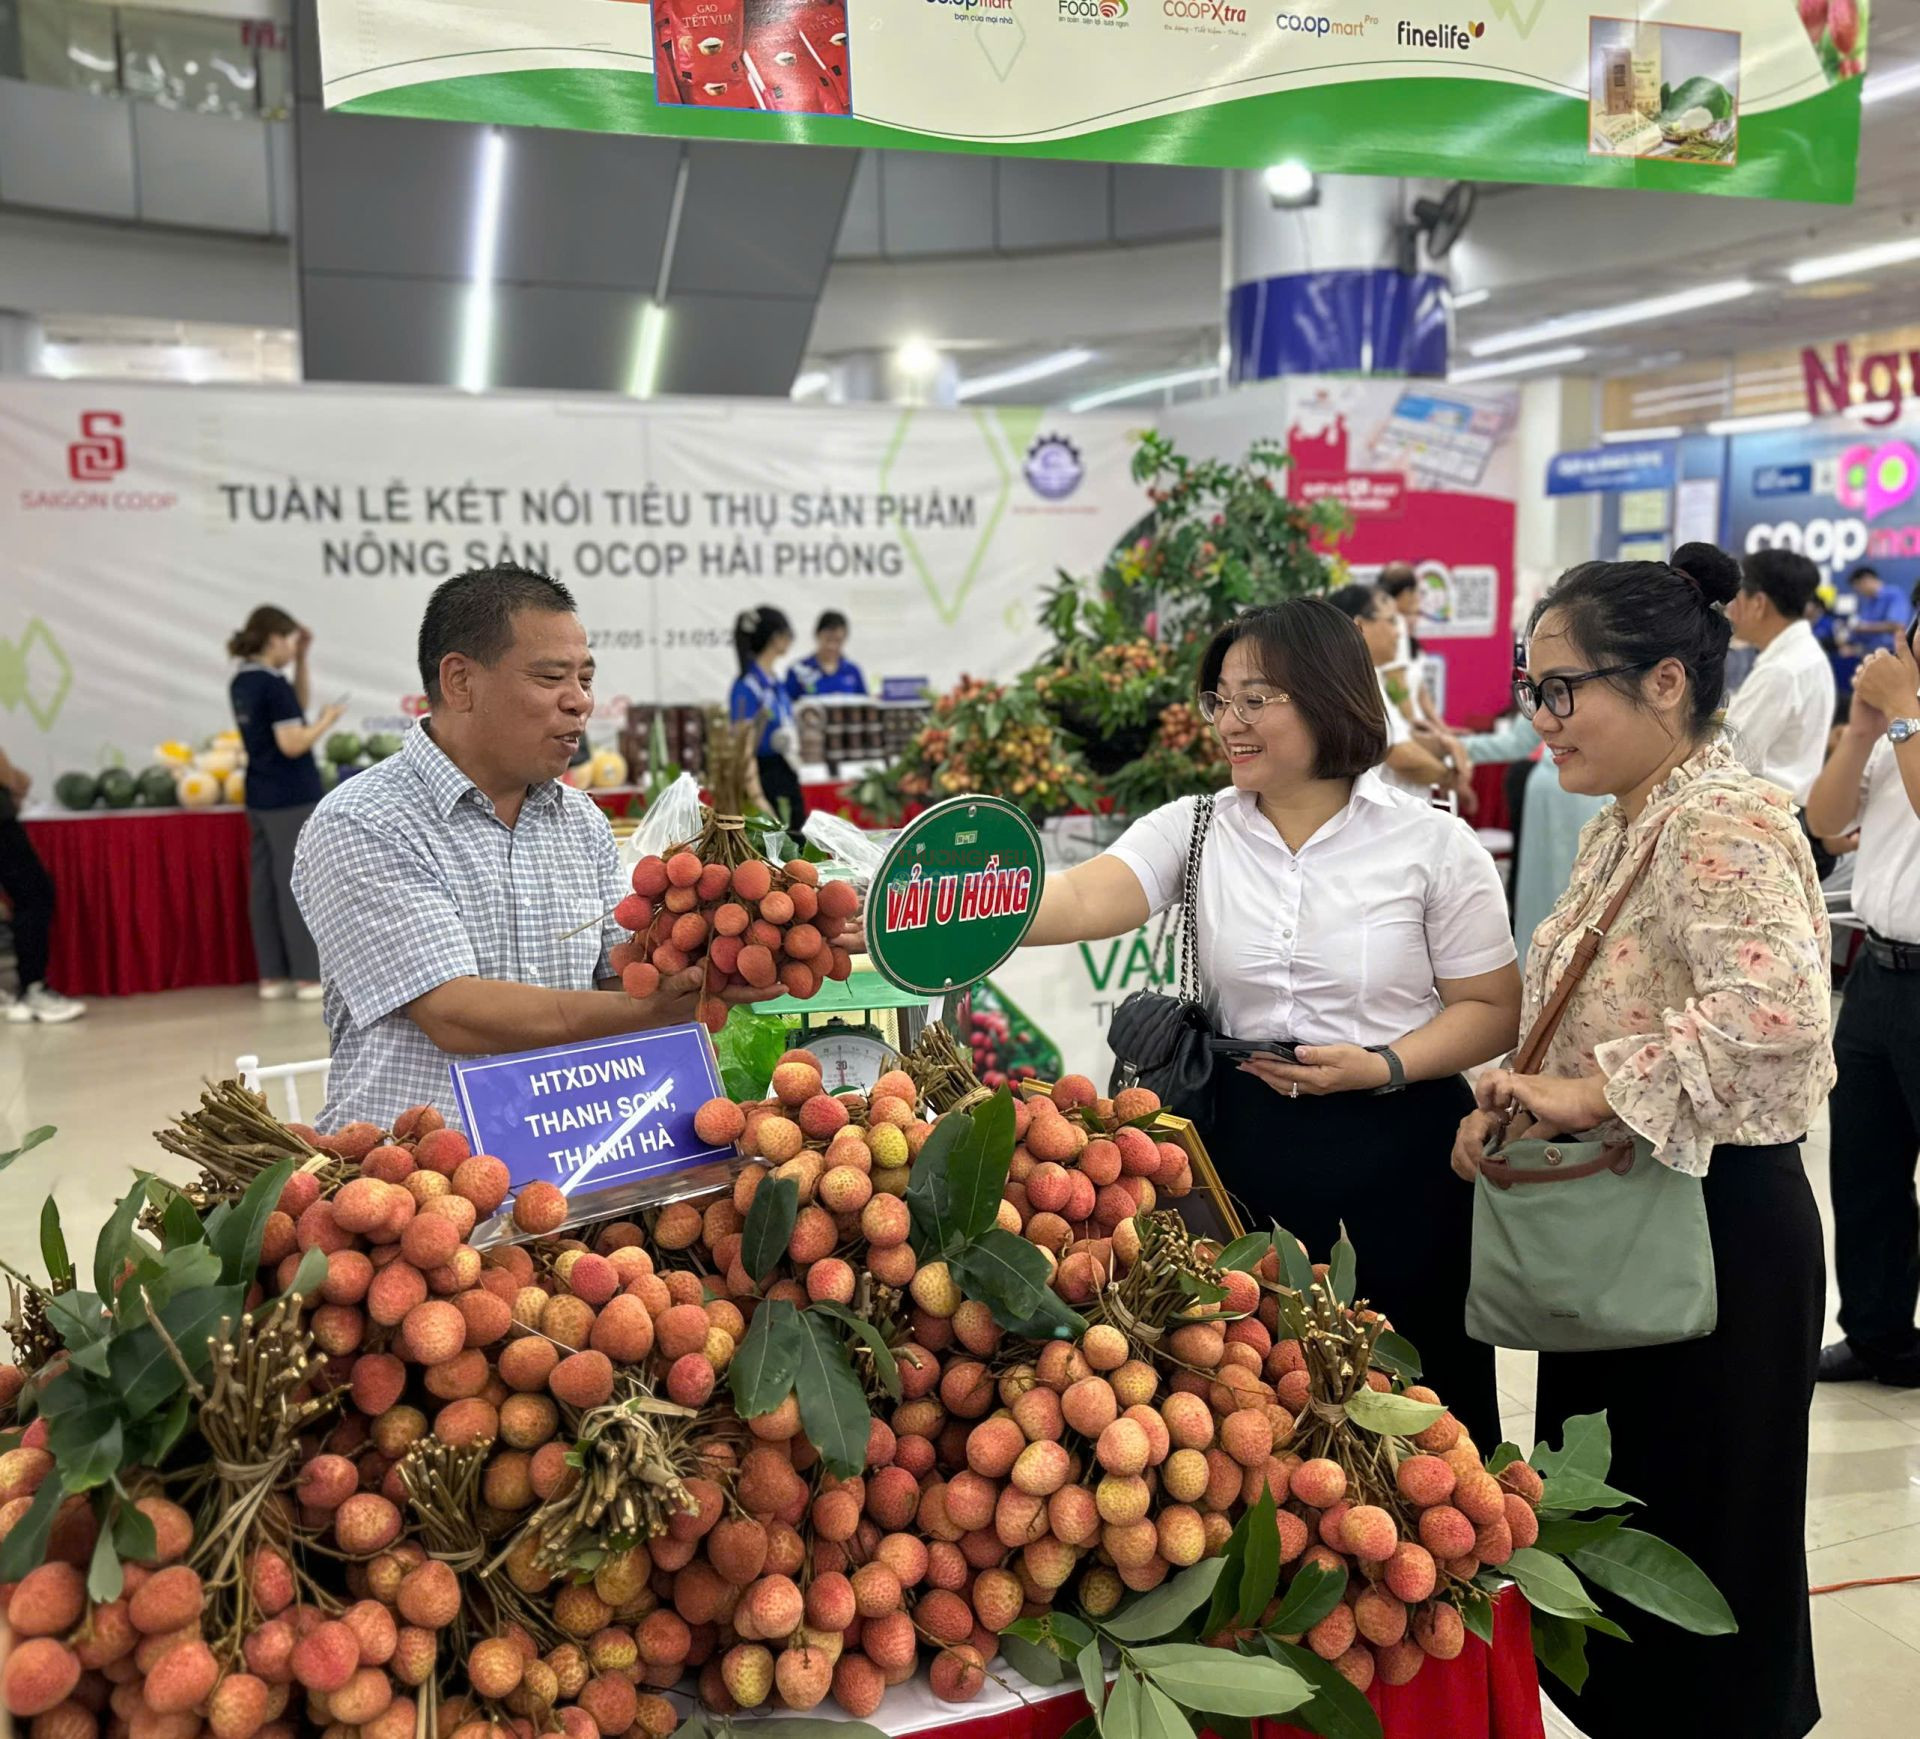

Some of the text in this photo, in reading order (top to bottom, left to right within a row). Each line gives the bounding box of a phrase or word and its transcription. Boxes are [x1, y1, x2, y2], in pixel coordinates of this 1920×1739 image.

[1397, 21, 1470, 50] finelife
[704, 492, 779, 535] THỤ
[322, 530, 451, 577] NÔNG
[574, 541, 688, 578] OCOP
[886, 863, 933, 933] VẢI
[935, 875, 958, 925] U
[959, 855, 1032, 922] HỒNG
[530, 1055, 646, 1097] HTXDVNN
[524, 1101, 613, 1138] THANH
[548, 1123, 676, 1174] THANH HÀ
